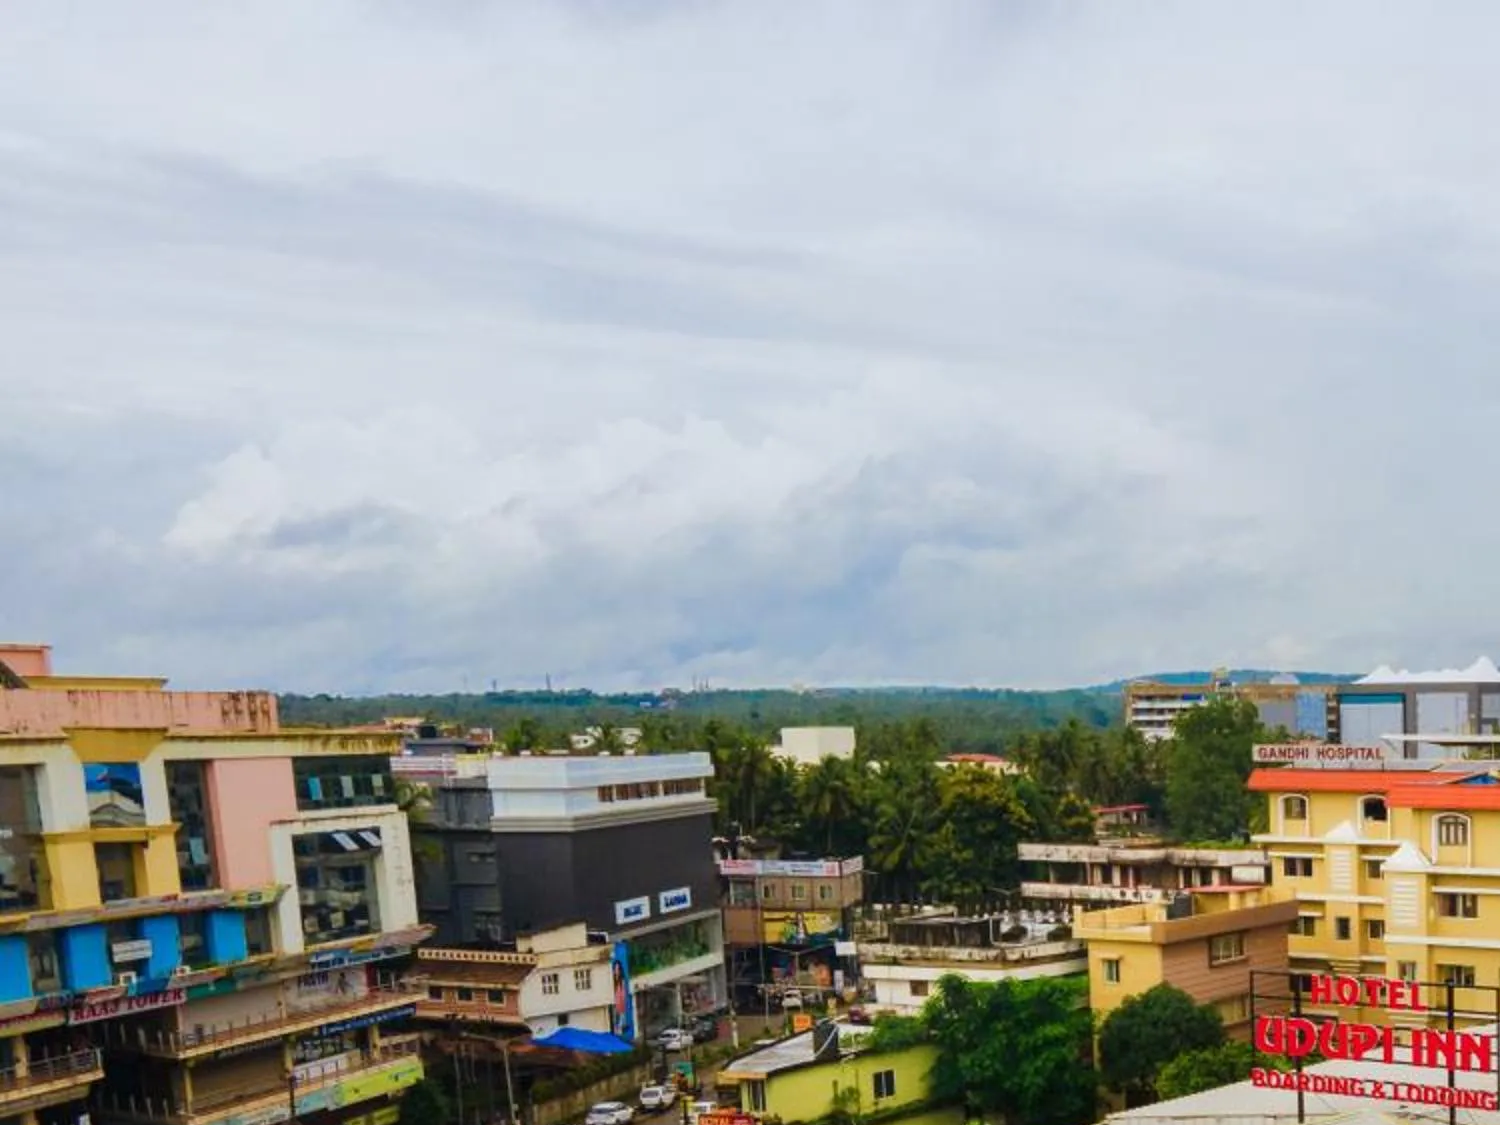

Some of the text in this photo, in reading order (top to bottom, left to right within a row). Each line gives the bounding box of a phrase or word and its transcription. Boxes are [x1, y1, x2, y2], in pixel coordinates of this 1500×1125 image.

[1259, 747, 1381, 760] GANDHI HOSPITAL
[1311, 974, 1428, 1012] HOTEL
[74, 1001, 119, 1022] RAAJ
[1255, 1015, 1491, 1073] UDUPI INN
[1251, 1067, 1365, 1097] BOARDING
[1371, 1082, 1386, 1099] &
